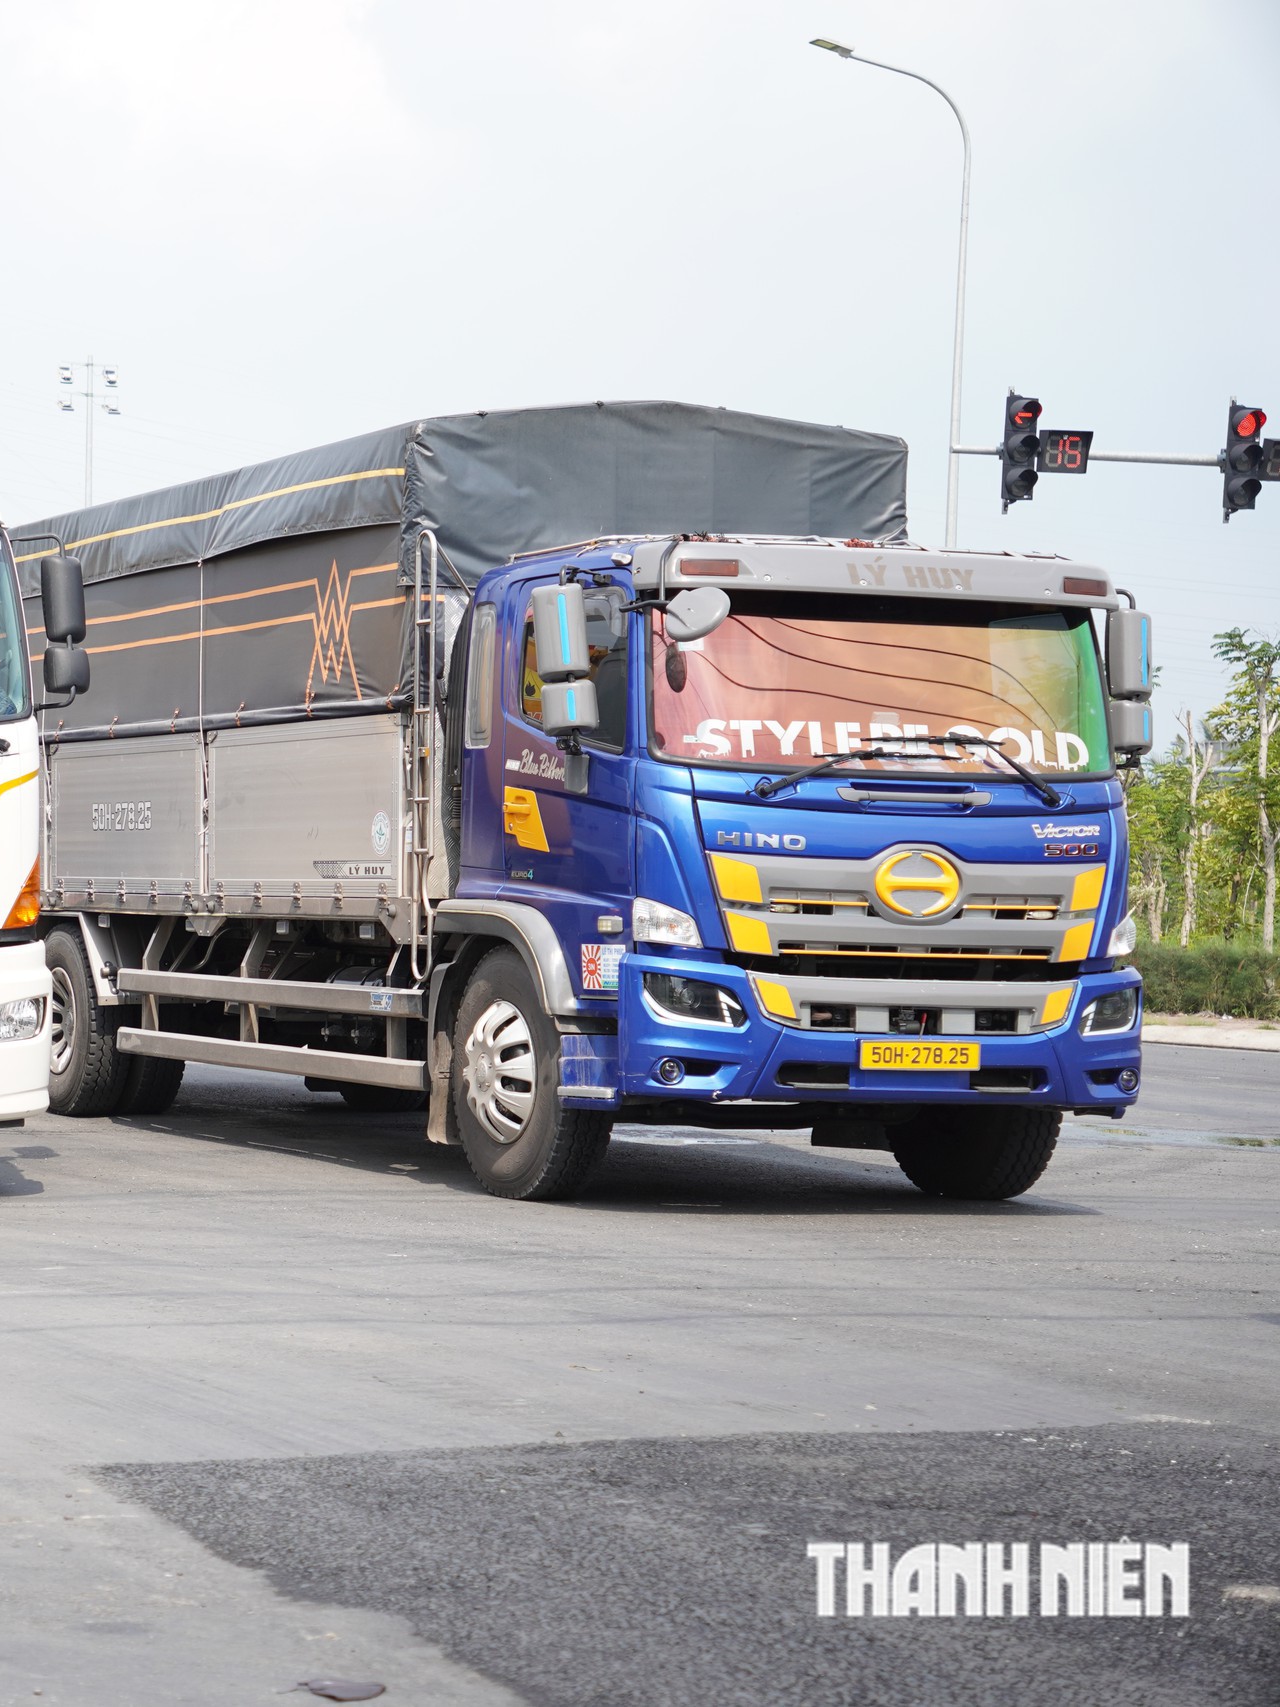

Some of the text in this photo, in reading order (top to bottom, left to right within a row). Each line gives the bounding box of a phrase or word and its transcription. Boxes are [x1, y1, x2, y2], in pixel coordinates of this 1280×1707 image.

[1057, 437, 1080, 468] 15
[846, 555, 974, 591] LÝ HUY
[92, 800, 152, 831] 50H-278.25
[717, 830, 807, 851] HINO
[1044, 843, 1099, 857] 500
[348, 864, 385, 875] LÝ HUY
[871, 1046, 970, 1064] 50H-278.25
